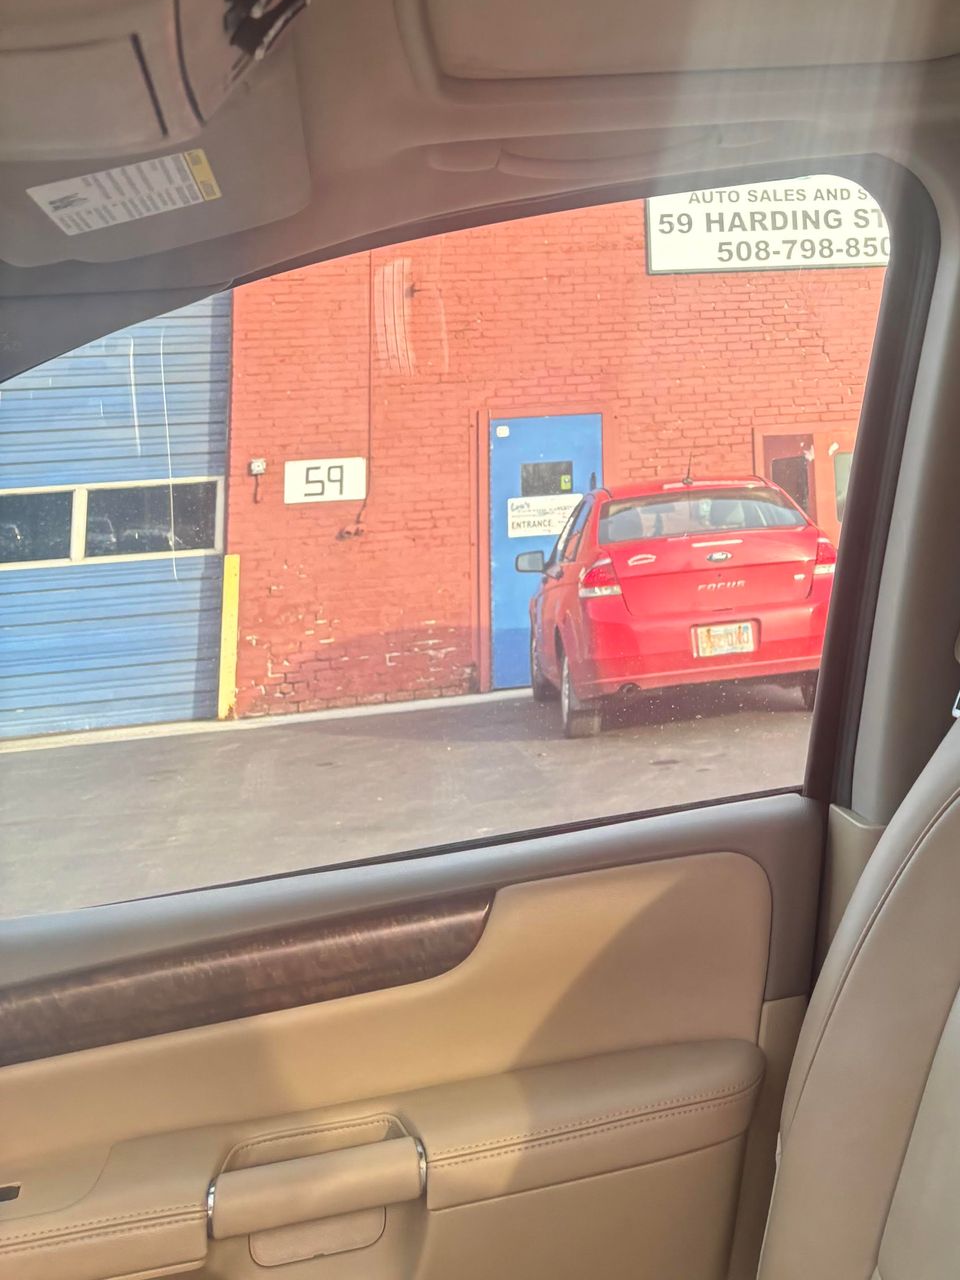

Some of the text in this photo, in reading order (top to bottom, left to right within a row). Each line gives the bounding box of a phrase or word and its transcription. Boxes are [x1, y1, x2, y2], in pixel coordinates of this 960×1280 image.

[688, 190, 740, 204] AUTO
[747, 188, 807, 203] SALES
[813, 187, 851, 201] AND
[658, 212, 693, 234] 59
[705, 208, 843, 233] HARDING
[304, 465, 344, 497] 59
[511, 519, 553, 530] ENTRANCE
